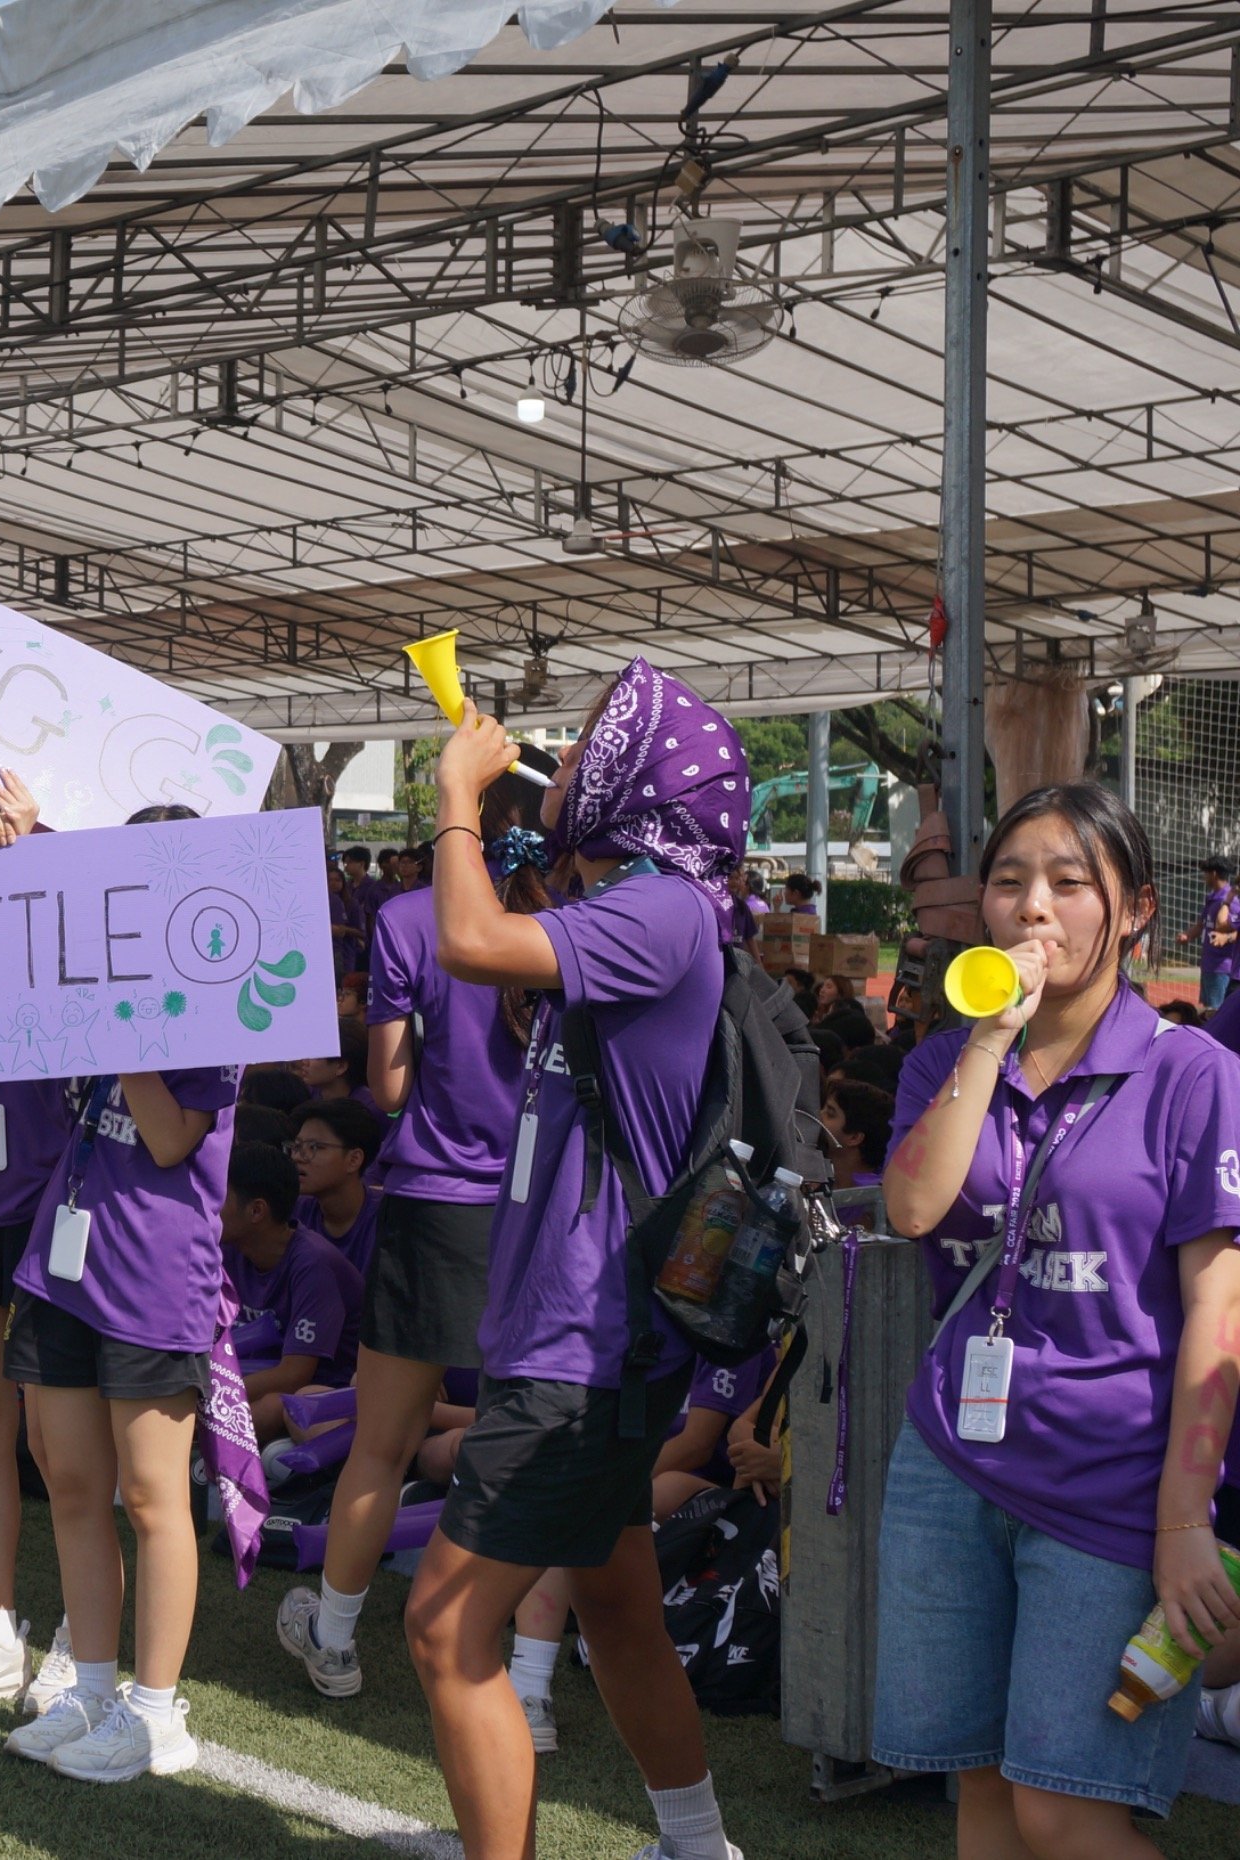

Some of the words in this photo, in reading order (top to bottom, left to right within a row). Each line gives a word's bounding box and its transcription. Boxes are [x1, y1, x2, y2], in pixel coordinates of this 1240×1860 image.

[98, 713, 213, 817] G
[165, 886, 262, 984] O
[712, 1369, 737, 1398] 35
